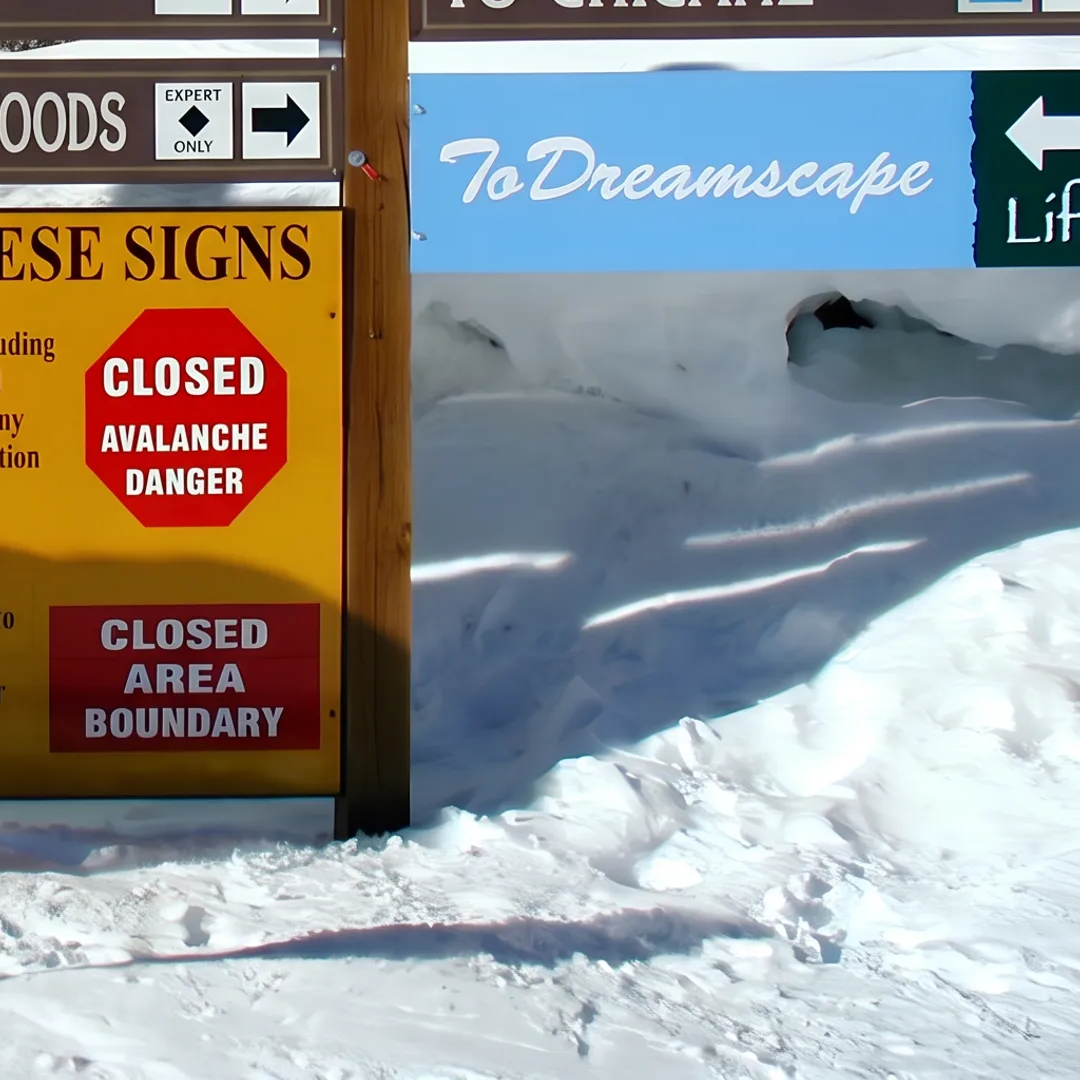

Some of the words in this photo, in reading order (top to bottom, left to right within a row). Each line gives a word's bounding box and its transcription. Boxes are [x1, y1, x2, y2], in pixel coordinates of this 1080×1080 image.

[165, 88, 222, 102] EXPERT
[173, 140, 214, 153] ONLY
[439, 136, 525, 204] To
[526, 135, 933, 214] Dreamscape
[124, 223, 311, 282] SIGNS
[103, 356, 265, 398] CLOSED
[101, 422, 268, 453] AVALANCHE
[126, 467, 243, 496] DANGER
[100, 618, 268, 651] CLOSED
[123, 663, 246, 694] AREA
[85, 706, 284, 739] BOUNDARY
